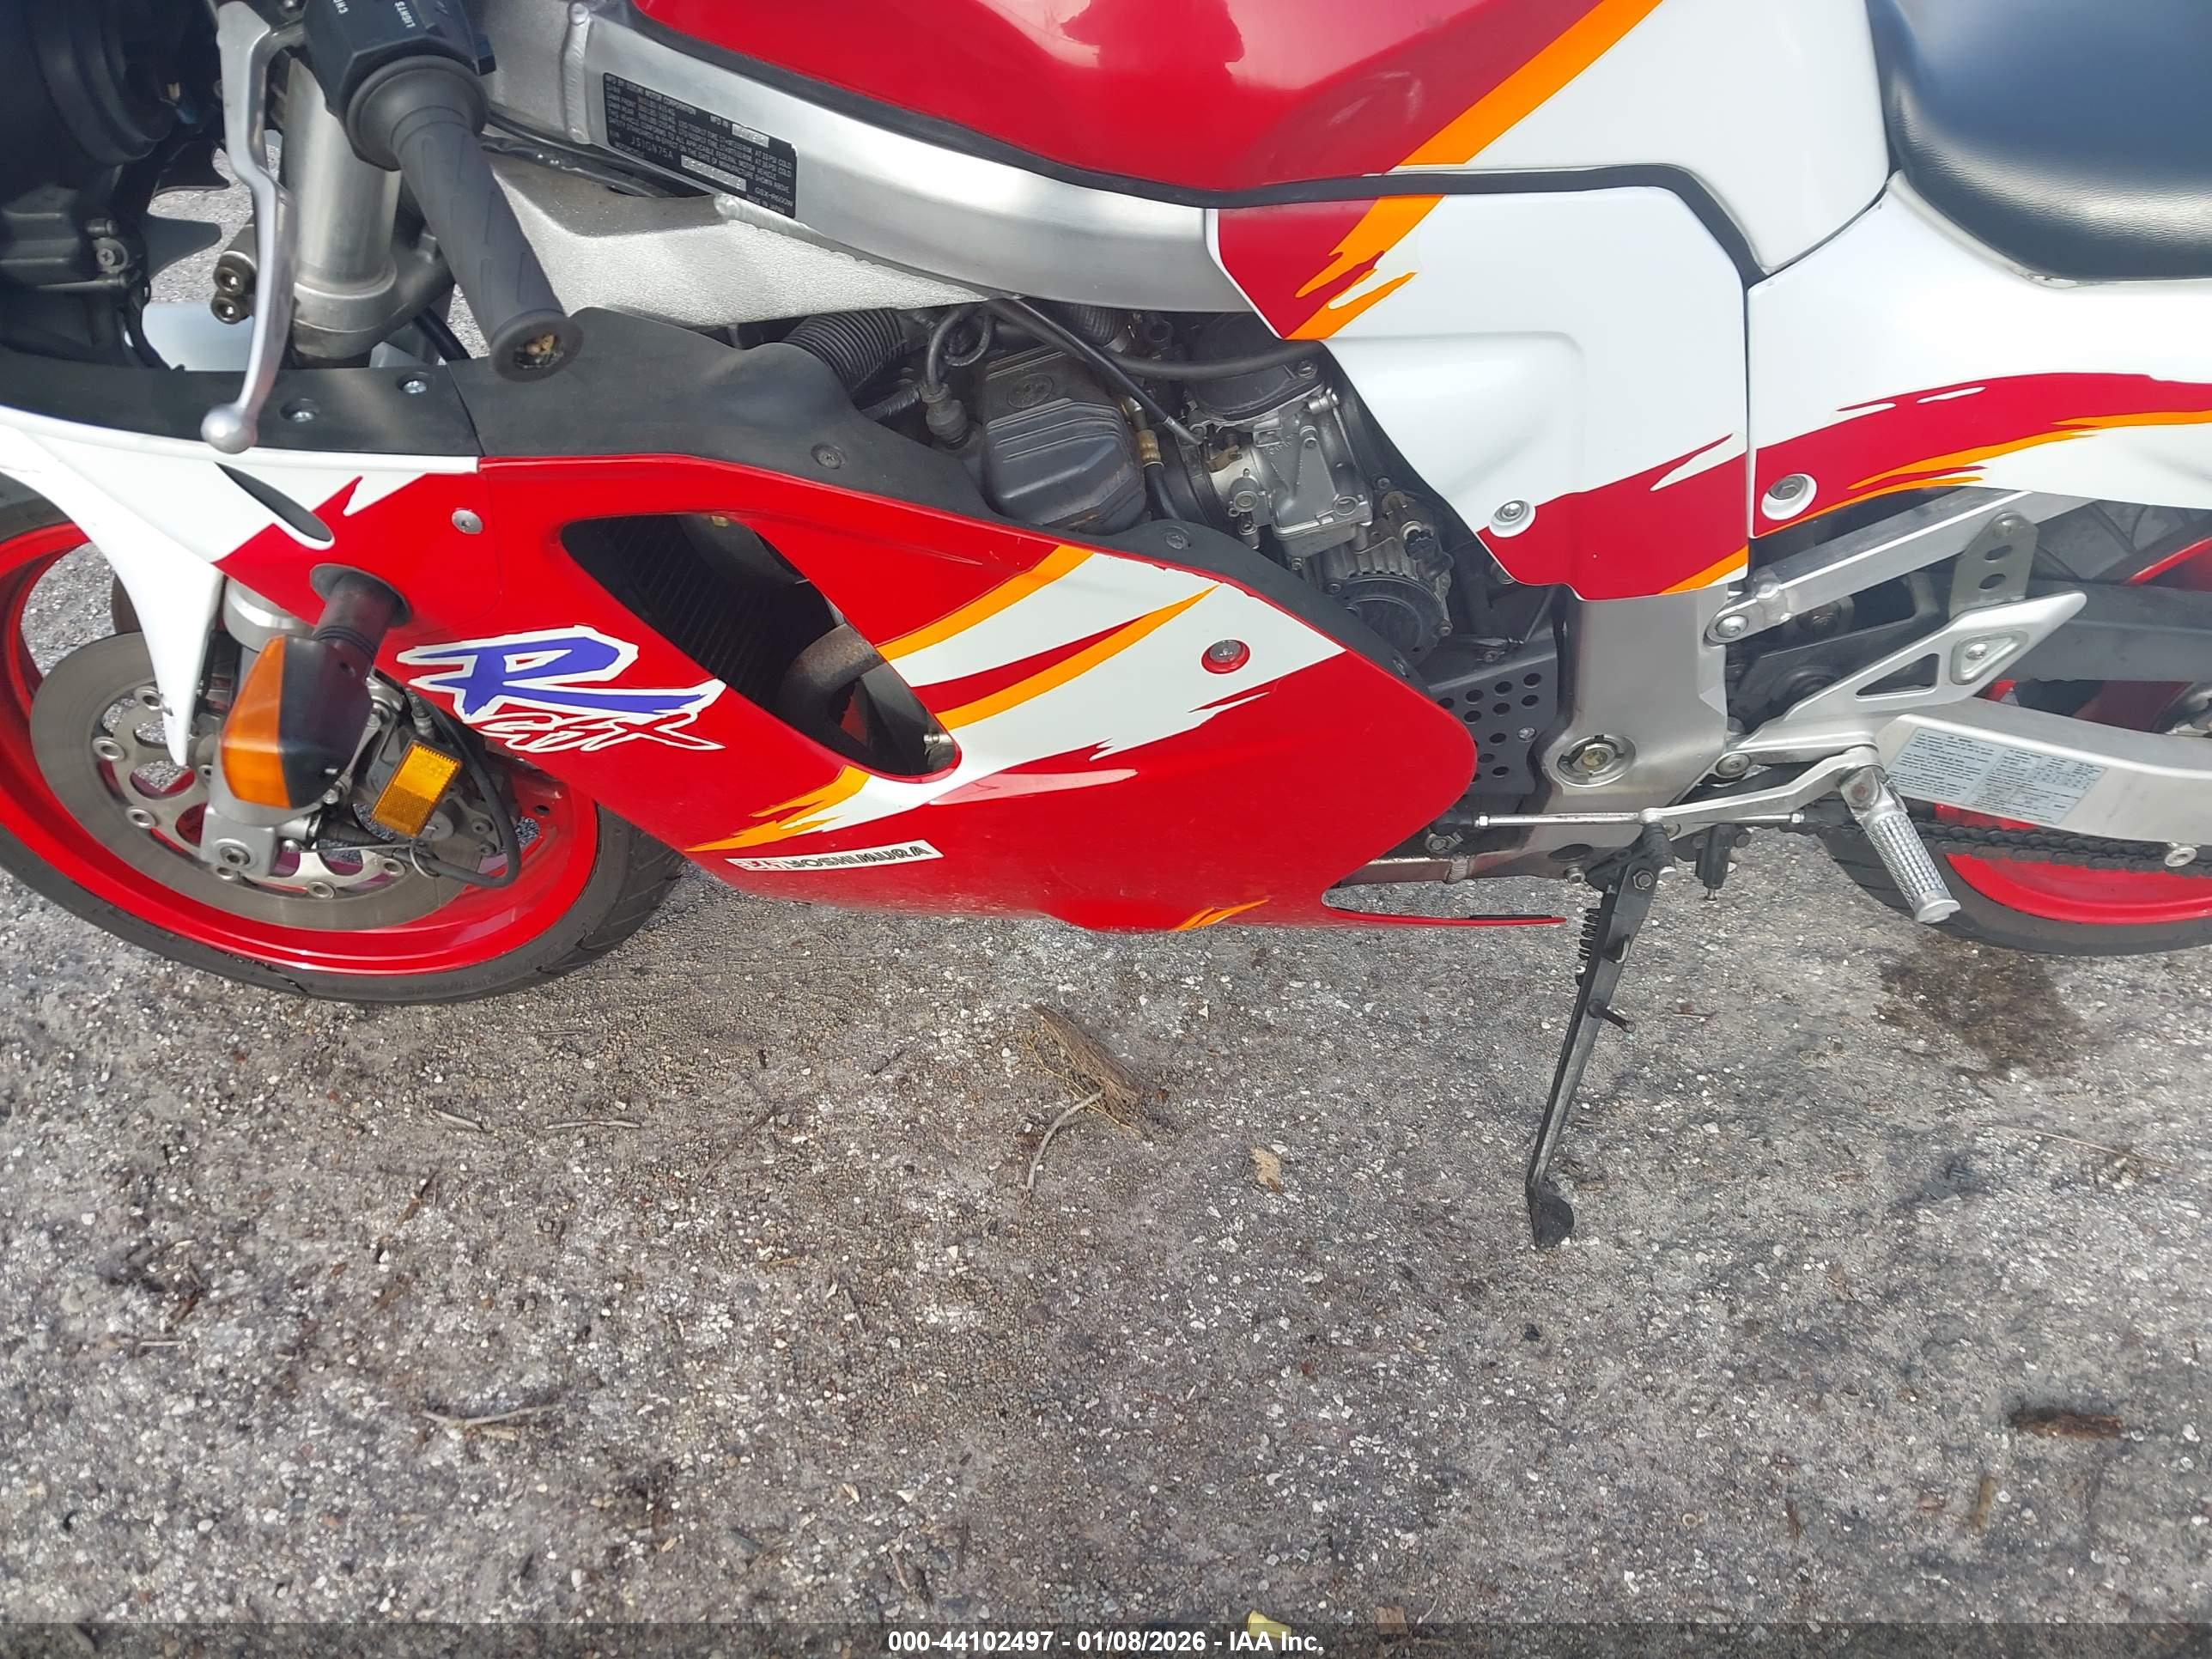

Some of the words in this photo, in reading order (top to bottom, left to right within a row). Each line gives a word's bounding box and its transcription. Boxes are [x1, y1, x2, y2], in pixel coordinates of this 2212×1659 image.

[395, 1, 416, 28] LIGHTS
[397, 625, 726, 724] R
[782, 846, 933, 869] YOSHIMURA
